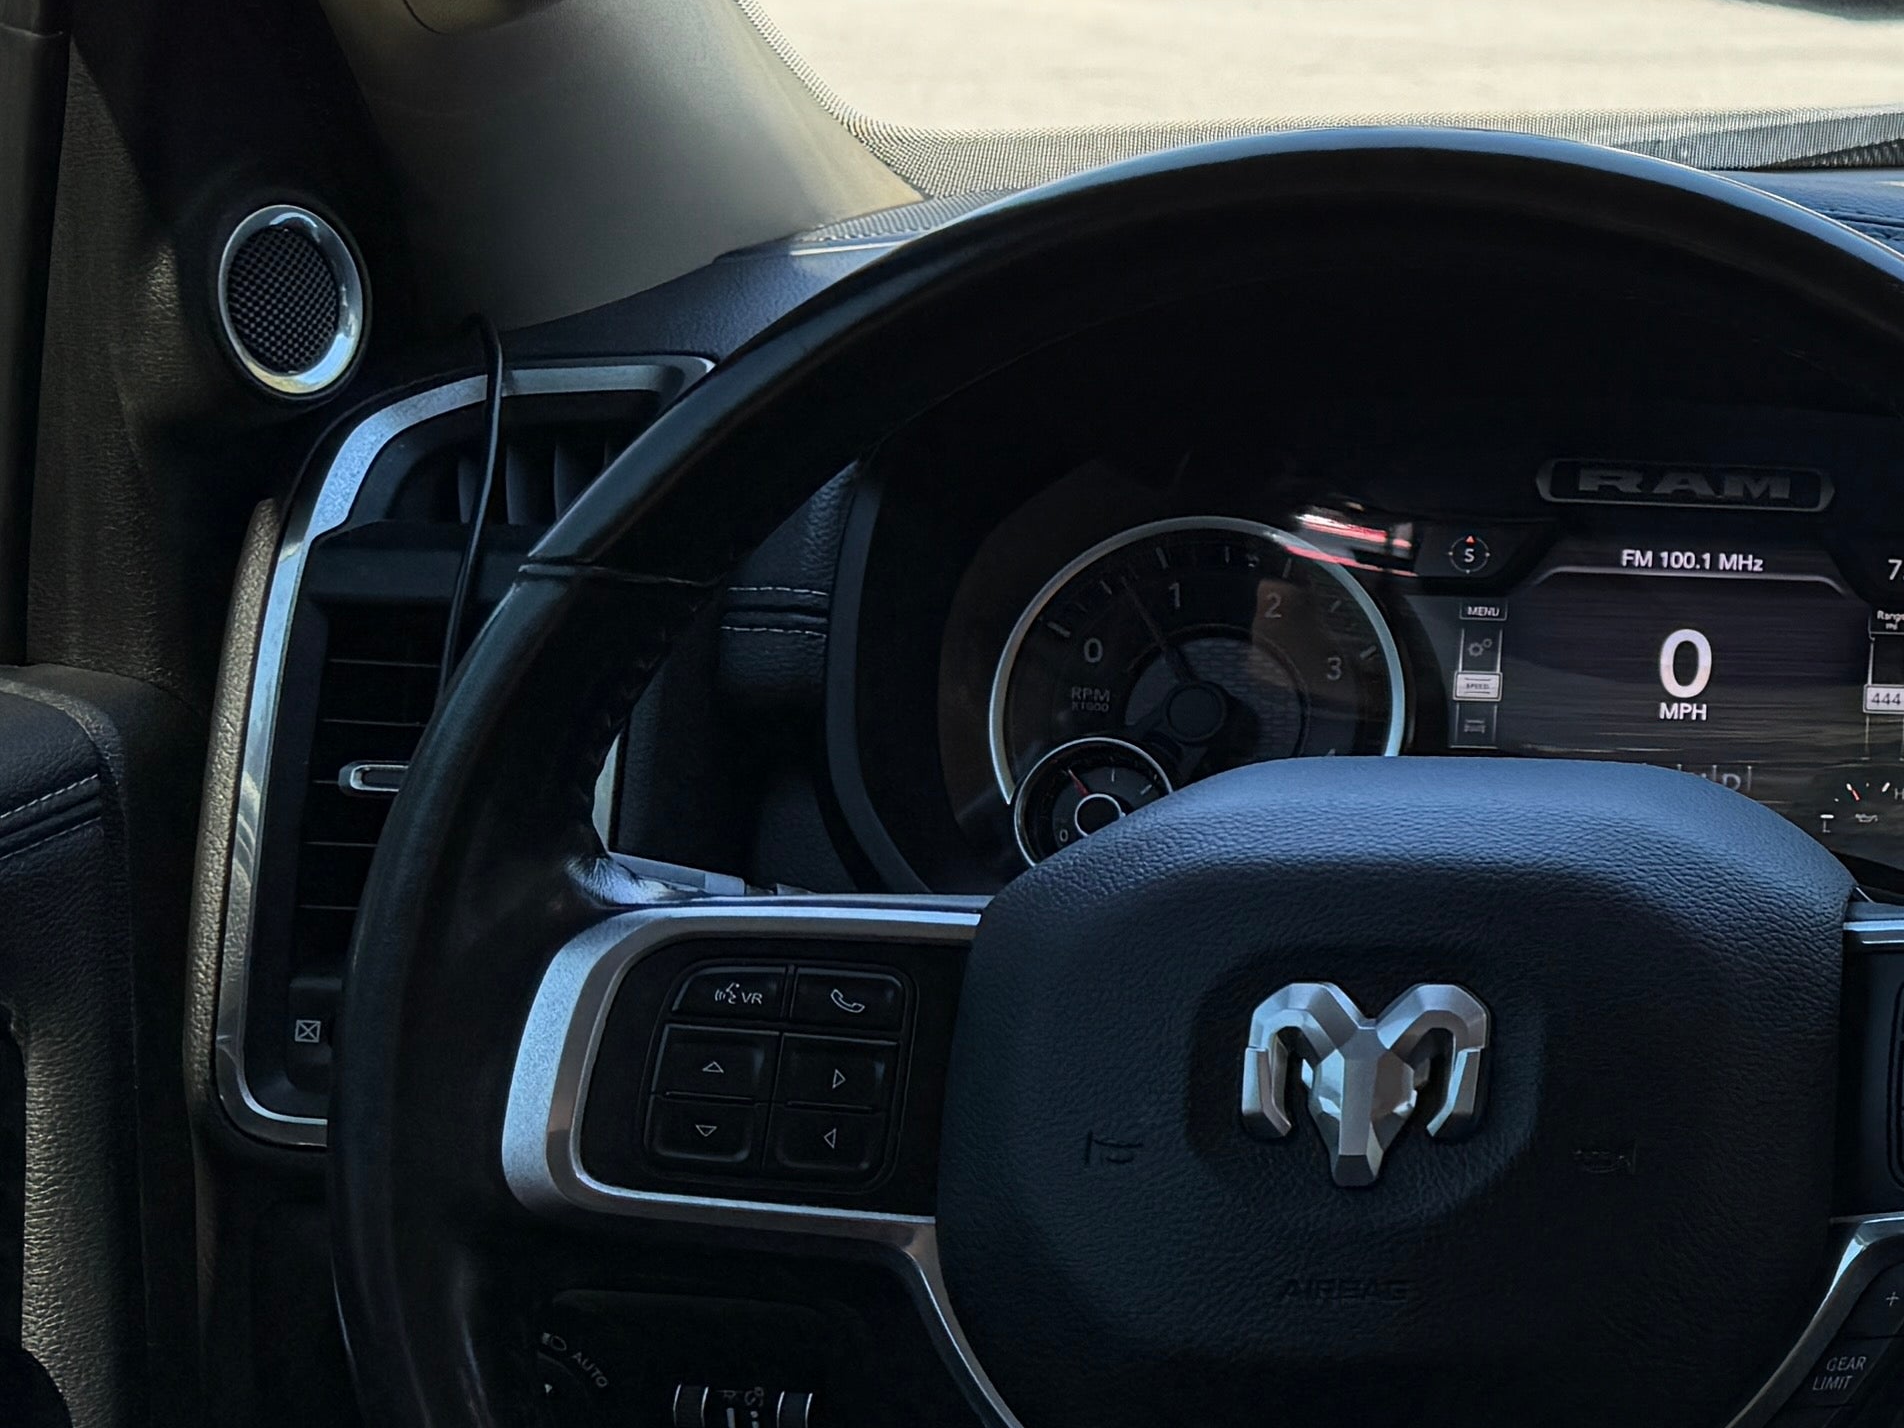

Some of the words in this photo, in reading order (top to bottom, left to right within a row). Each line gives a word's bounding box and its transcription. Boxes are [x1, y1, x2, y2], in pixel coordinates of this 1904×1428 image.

[1576, 470, 1793, 502] RAM
[1620, 548, 1653, 569] FM
[1659, 549, 1714, 571] 100.1
[1718, 552, 1765, 574] MHz
[1168, 581, 1182, 609] 1
[1263, 593, 1283, 620] 2
[1466, 605, 1501, 618] MENU
[1083, 637, 1103, 664] 0
[1326, 656, 1343, 680] 3
[1658, 628, 1714, 700] 0
[1071, 685, 1111, 703] RPM
[1870, 691, 1903, 707] 444
[1658, 702, 1709, 722] MPH
[740, 991, 763, 1006] VR
[569, 1349, 611, 1390] AUTO
[1825, 1355, 1868, 1373] GEAR
[1811, 1374, 1854, 1392] LIMIT
